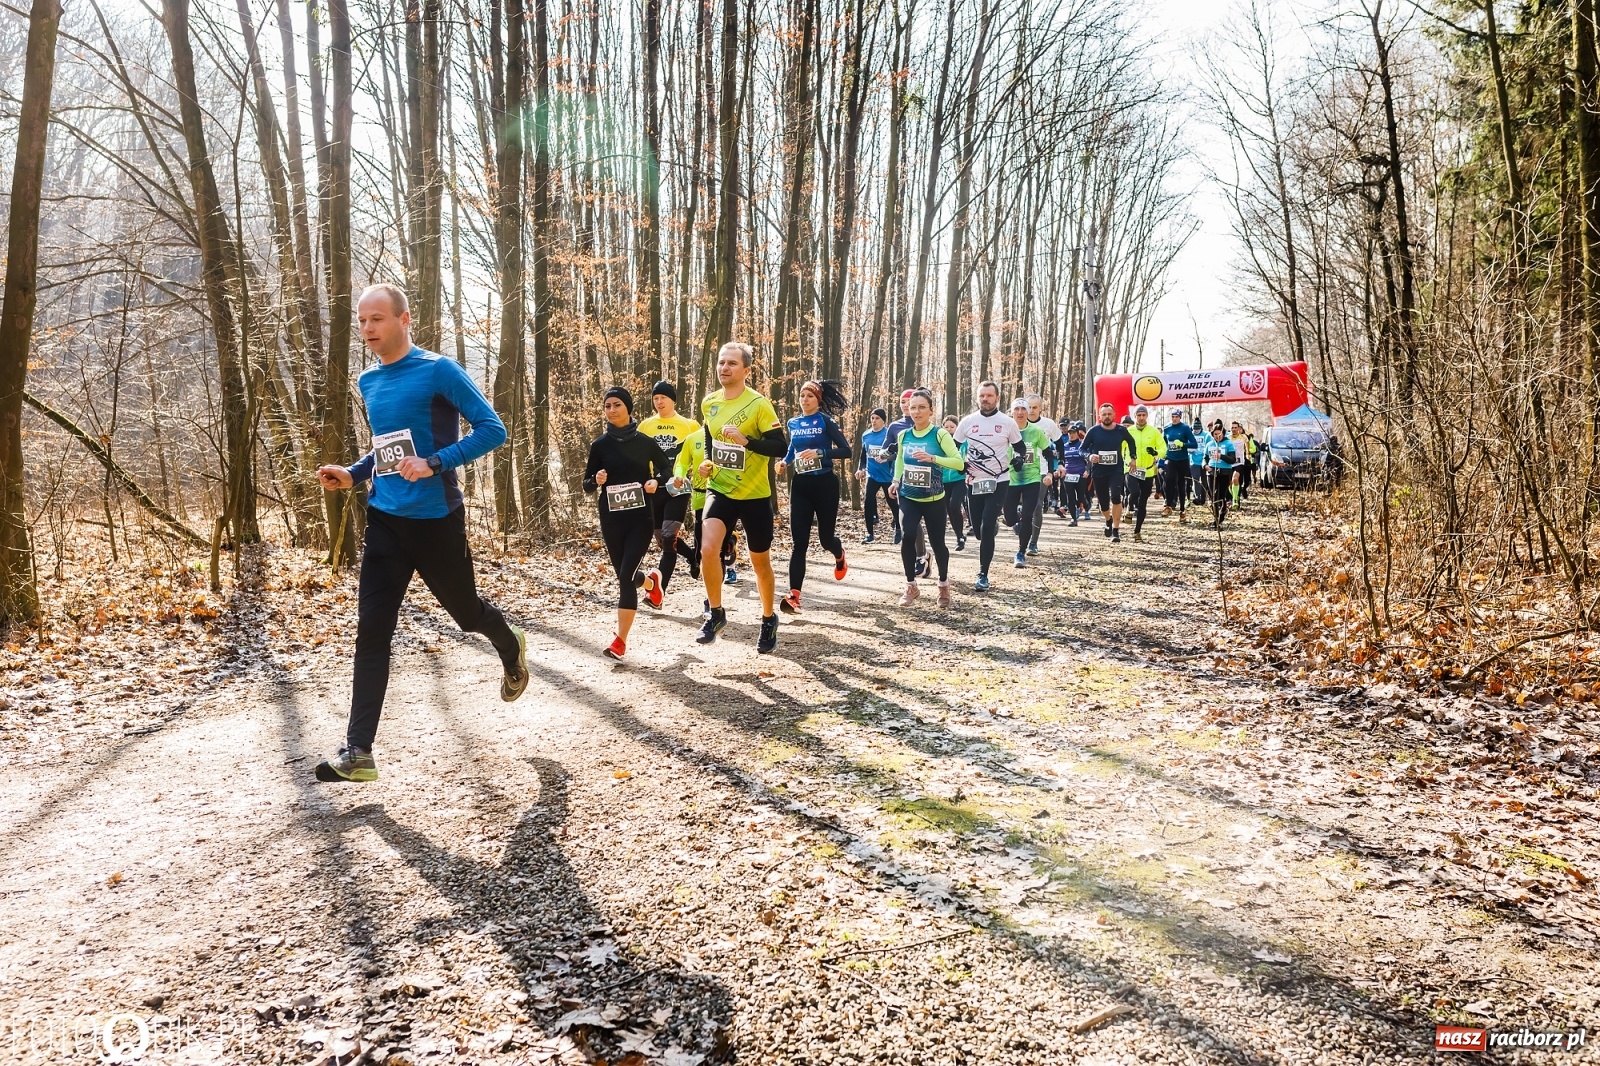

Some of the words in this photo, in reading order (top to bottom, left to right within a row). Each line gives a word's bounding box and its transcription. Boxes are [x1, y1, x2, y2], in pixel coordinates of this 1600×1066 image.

[1187, 372, 1211, 380] BIEG
[1168, 380, 1231, 391] TWARDZIELA
[1175, 390, 1225, 400] RACIBÓRZ
[380, 445, 405, 463] 089
[717, 449, 737, 462] 079
[908, 471, 925, 482] 092
[978, 481, 990, 489] 114
[614, 490, 637, 503] 044
